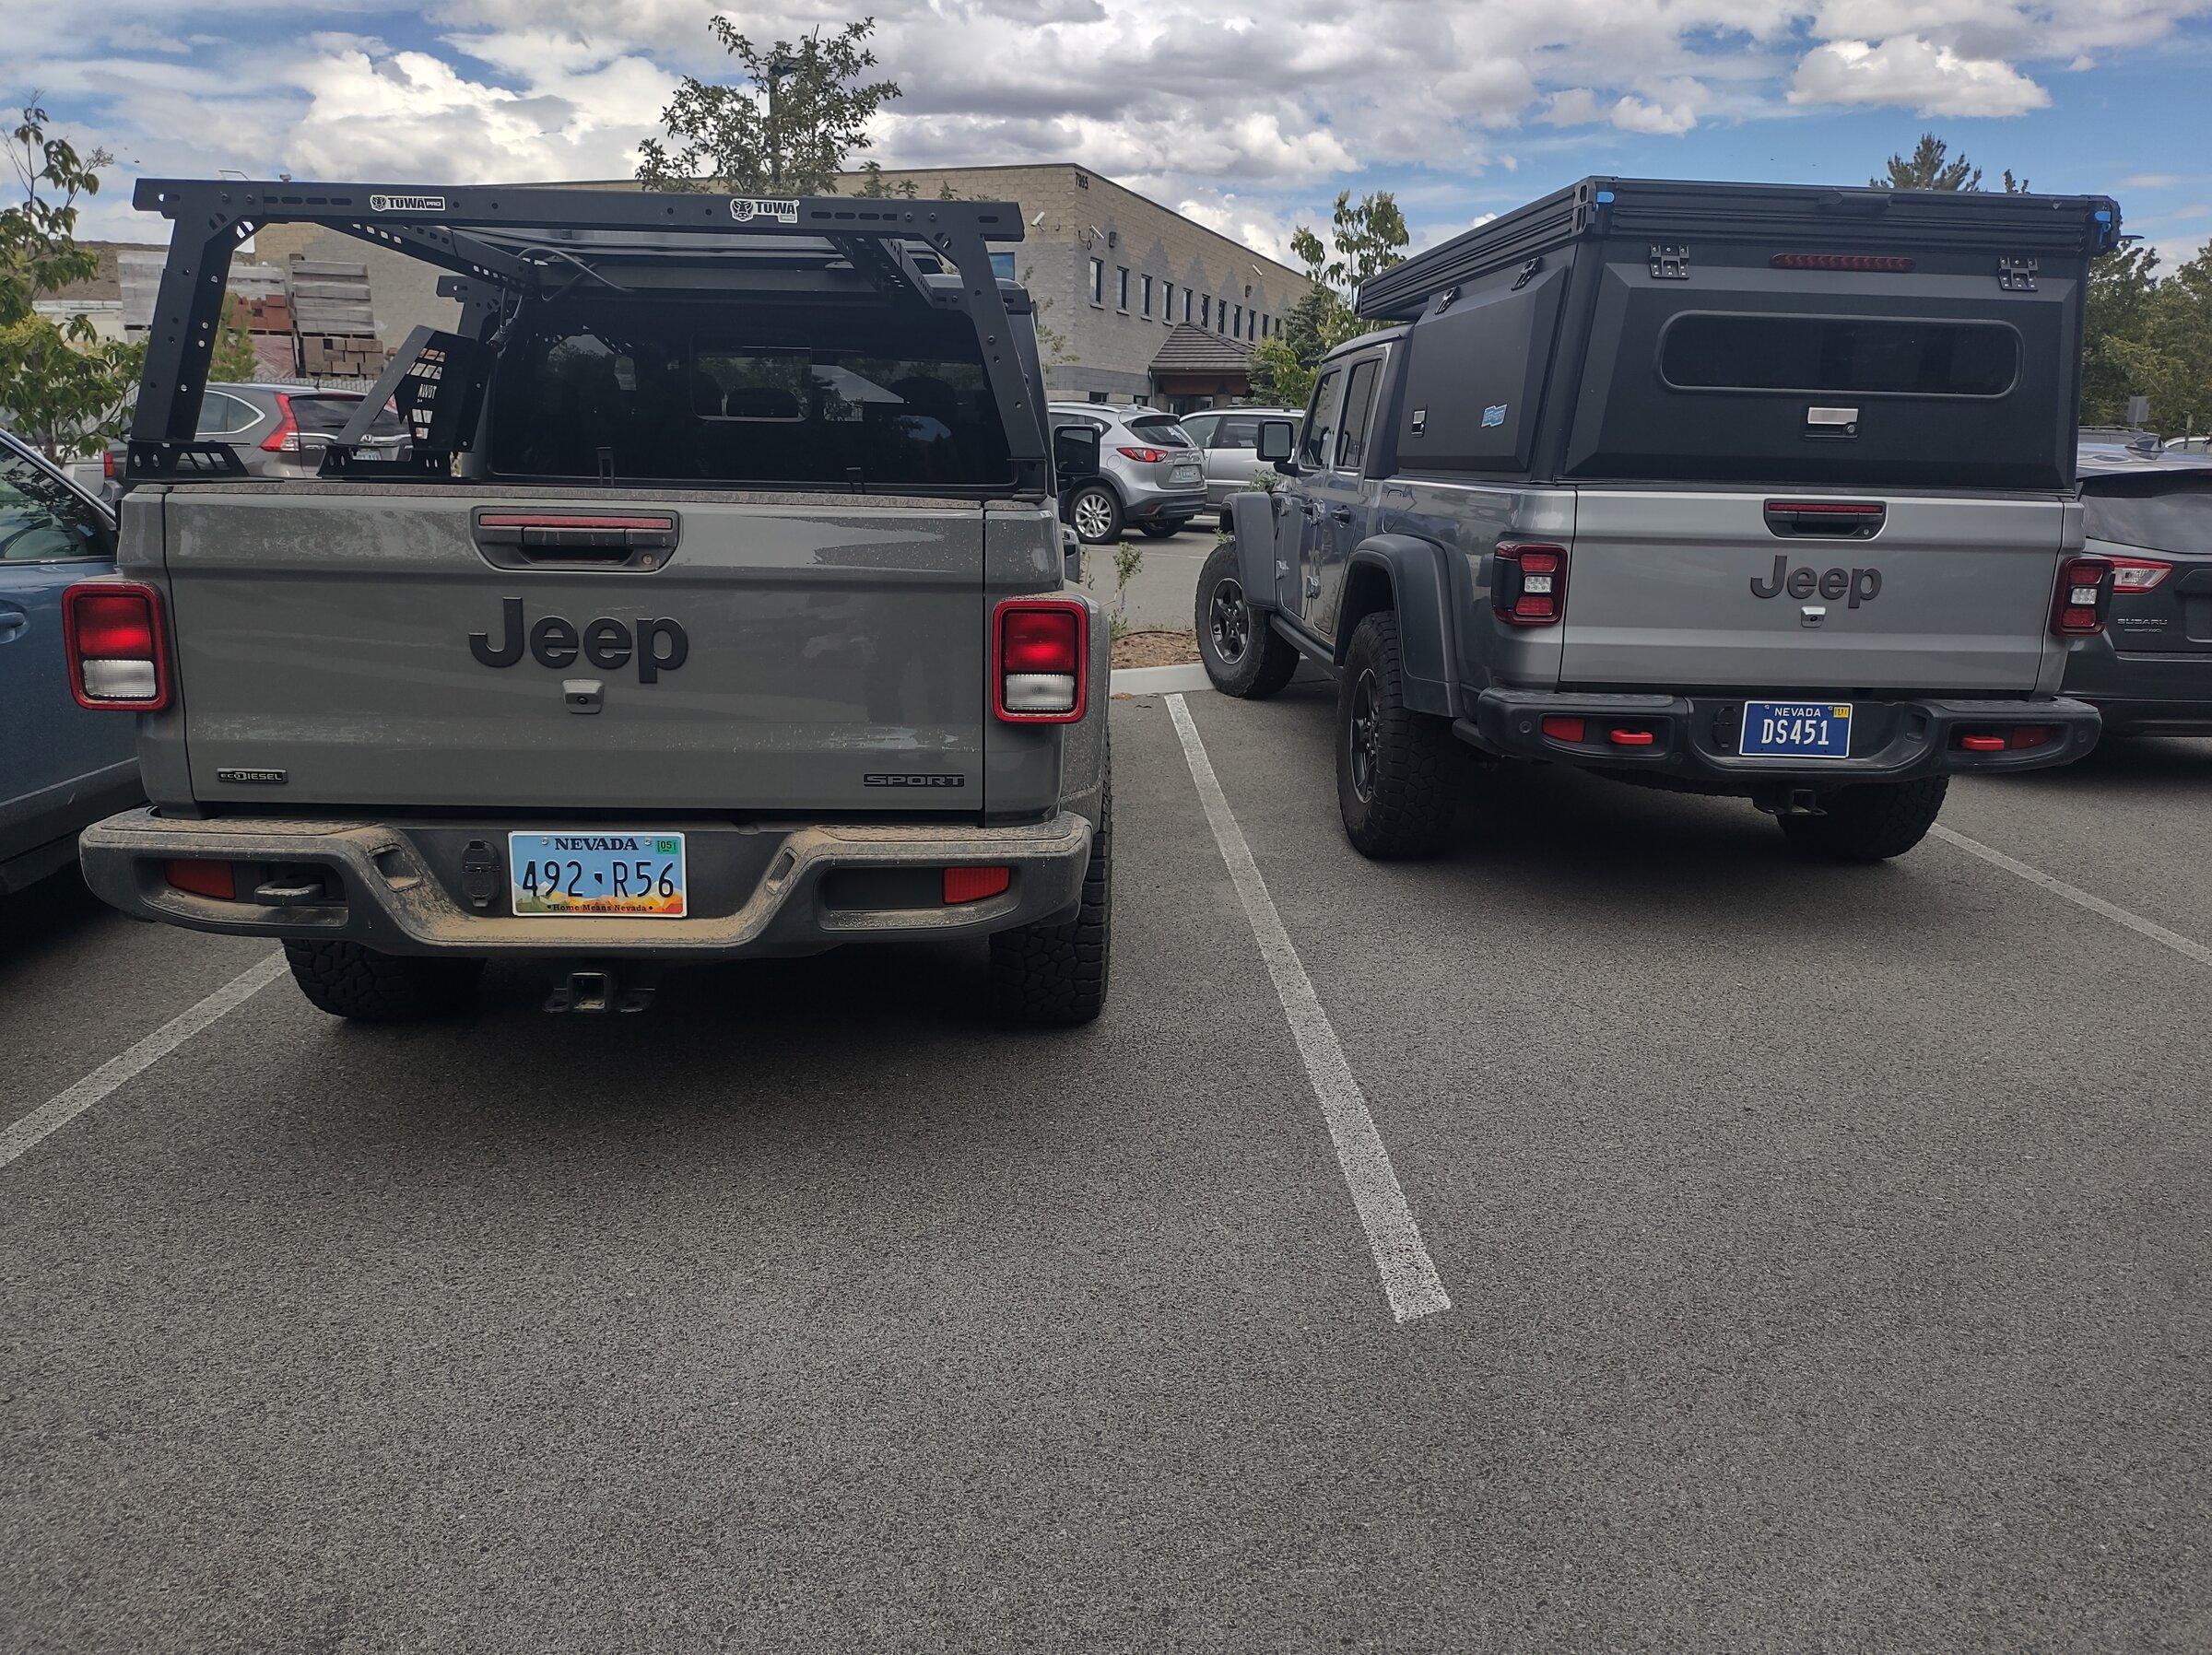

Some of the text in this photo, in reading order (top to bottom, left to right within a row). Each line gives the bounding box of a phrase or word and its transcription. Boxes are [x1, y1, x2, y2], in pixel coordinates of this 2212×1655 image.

[1750, 555, 1882, 609] Jeep
[468, 596, 688, 684] Jeep
[1774, 708, 1821, 717] NEVADA
[1761, 719, 1829, 745] DS451
[865, 776, 965, 786] SPORT
[555, 838, 639, 851] NEVADA
[661, 840, 672, 850] 05
[553, 903, 647, 912] Home Means Nevada
